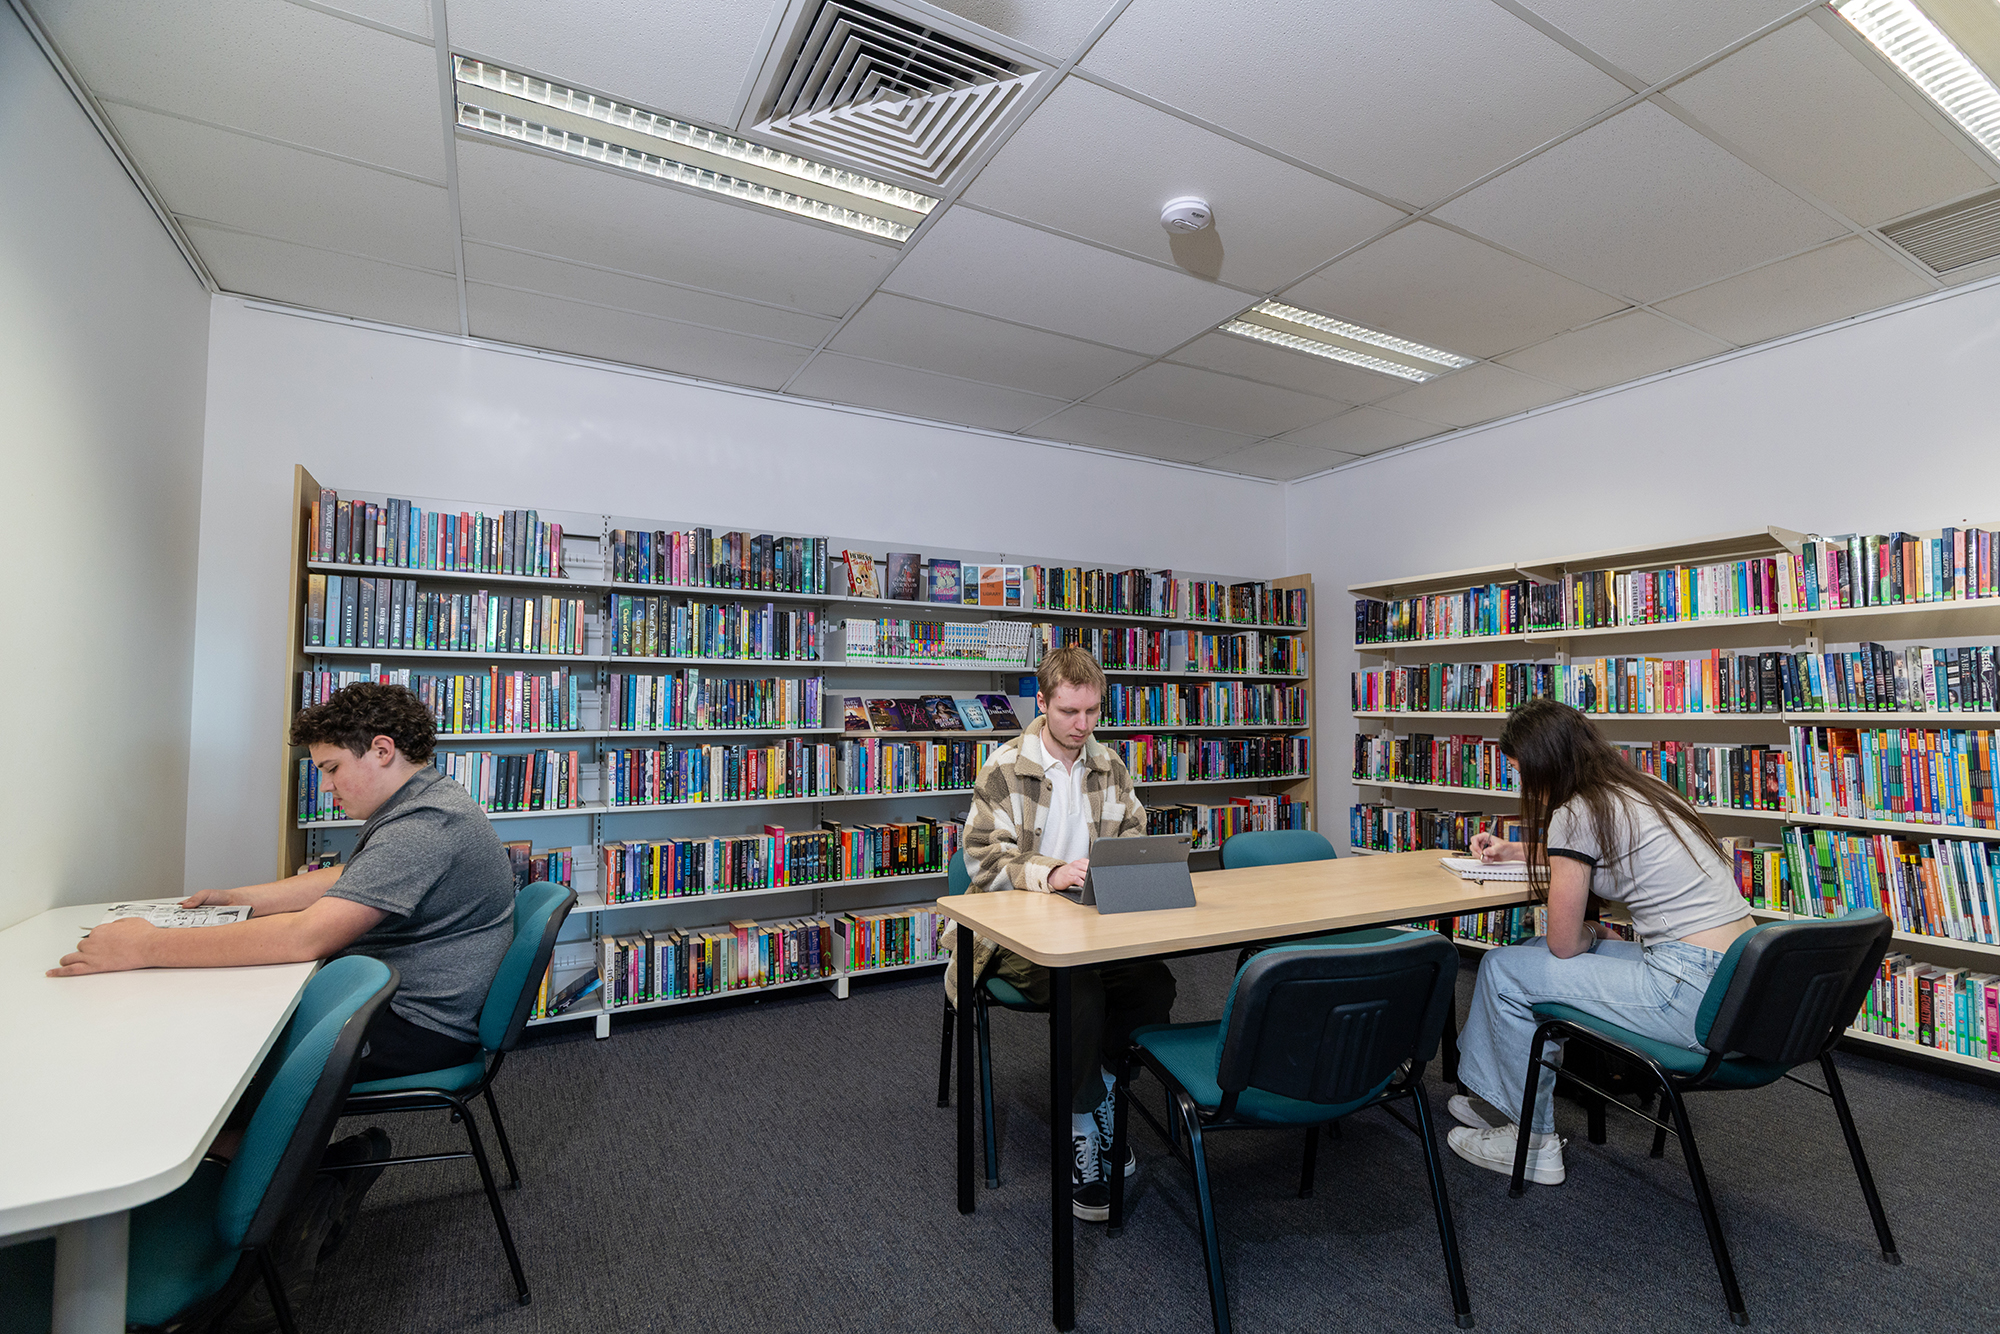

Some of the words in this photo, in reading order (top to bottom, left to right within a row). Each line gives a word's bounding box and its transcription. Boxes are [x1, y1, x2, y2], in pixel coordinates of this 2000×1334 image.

[1820, 755, 1829, 772] FLY
[1754, 854, 1763, 885] REBOOT
[1843, 858, 1851, 881] BIOLOGY
[1920, 995, 1931, 1024] GEOMETRY
